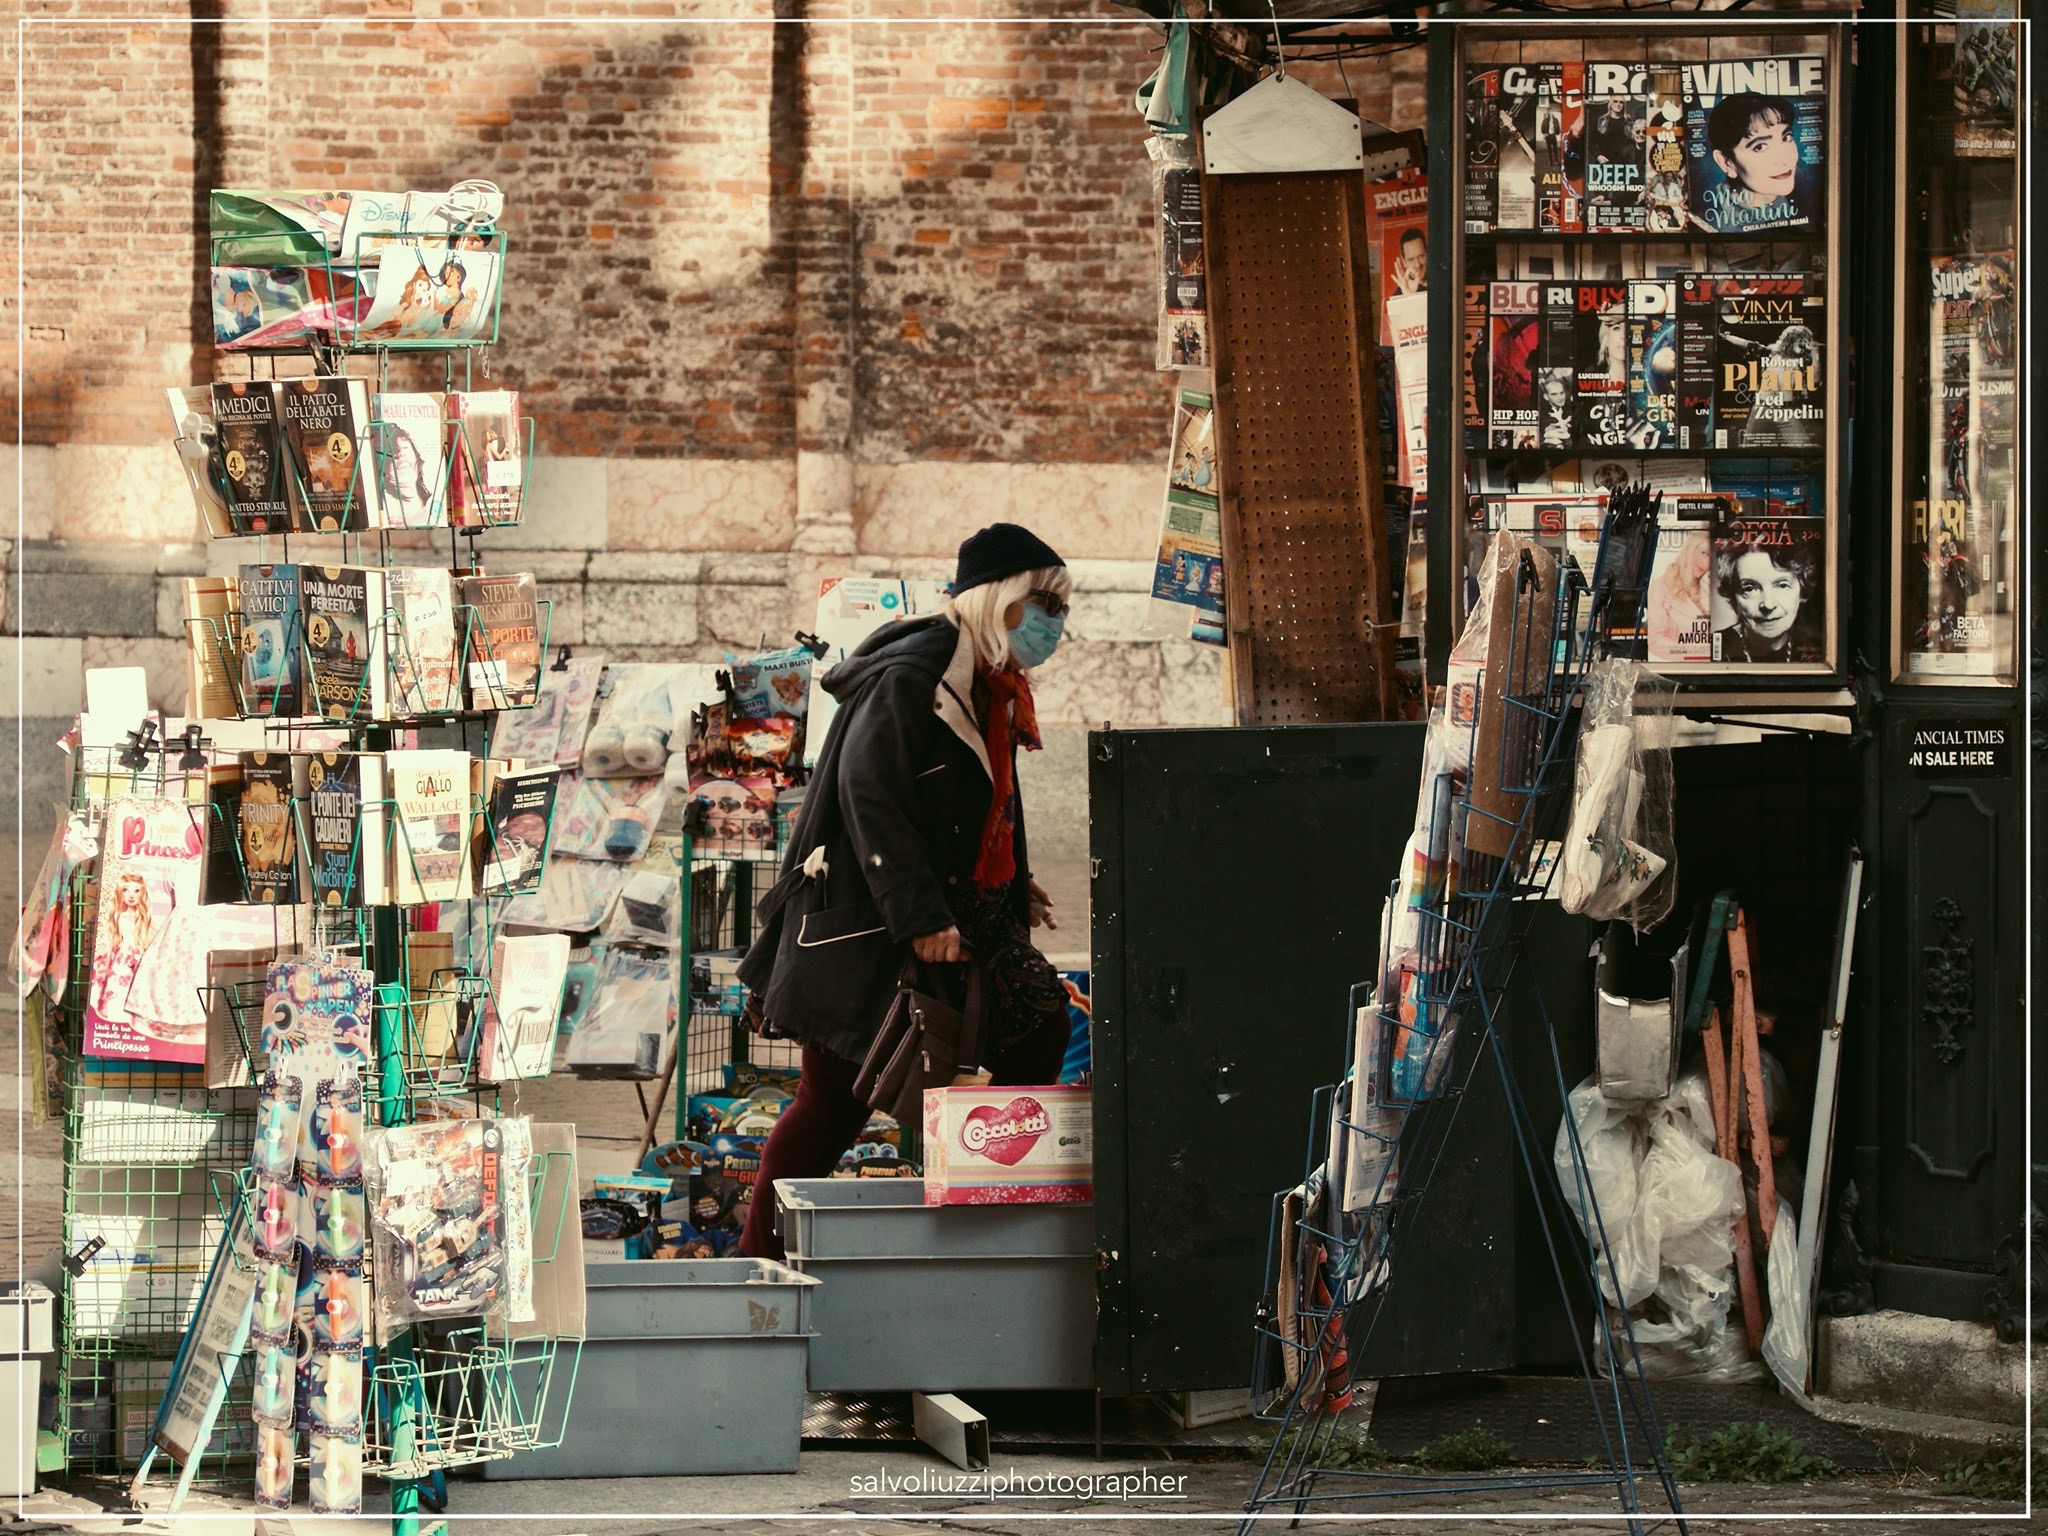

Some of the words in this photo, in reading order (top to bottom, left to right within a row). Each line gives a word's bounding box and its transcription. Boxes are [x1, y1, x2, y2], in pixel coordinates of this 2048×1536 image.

[1690, 60, 1824, 107] VINILE
[1589, 164, 1639, 185] DEEP
[1702, 188, 1752, 209] Mia
[1705, 200, 1798, 229] Martini
[1732, 300, 1804, 321] VINYL
[1761, 357, 1804, 368] Robert
[1723, 361, 1818, 392] Plant
[222, 396, 270, 415] MEDICI
[289, 395, 299, 406] IL
[303, 393, 337, 405] PATTO
[1754, 392, 1784, 406] Led
[286, 404, 346, 418] DELL'ABATE
[383, 404, 407, 418] MARIA
[1493, 410, 1514, 420] HIP
[1515, 410, 1539, 420] HOP
[1754, 405, 1824, 422] Zeppelin
[300, 417, 332, 430] NERO
[1715, 521, 1794, 545] OESIA
[241, 579, 293, 596] CATTIVI
[304, 580, 323, 595] UNA
[327, 583, 364, 600] MORTE
[482, 583, 520, 602] STEVEN
[246, 597, 287, 613] AMICI
[311, 596, 356, 613] PERFETTA
[475, 602, 533, 623] RESSFIELD
[1957, 616, 1985, 629] BETA
[493, 626, 535, 645] PORTE
[1953, 629, 1990, 639] FACTORY
[764, 663, 788, 672] MAXI
[1914, 731, 1963, 745] ANCIAL
[1964, 730, 2005, 744] TIMES
[1925, 751, 1958, 766] SALE
[1960, 751, 1994, 766] HERE
[416, 776, 452, 797] GIALLO
[243, 804, 288, 823] TRINITY
[318, 792, 341, 817] PONTE
[342, 792, 356, 818] DEI
[405, 798, 463, 815] WALLACE
[315, 818, 351, 843] CADAVERI
[326, 851, 350, 871] Stuart
[269, 870, 292, 880] Calan
[327, 999, 354, 1014] PEN
[93, 1037, 151, 1053] Principessa
[415, 1287, 459, 1304] TANK
